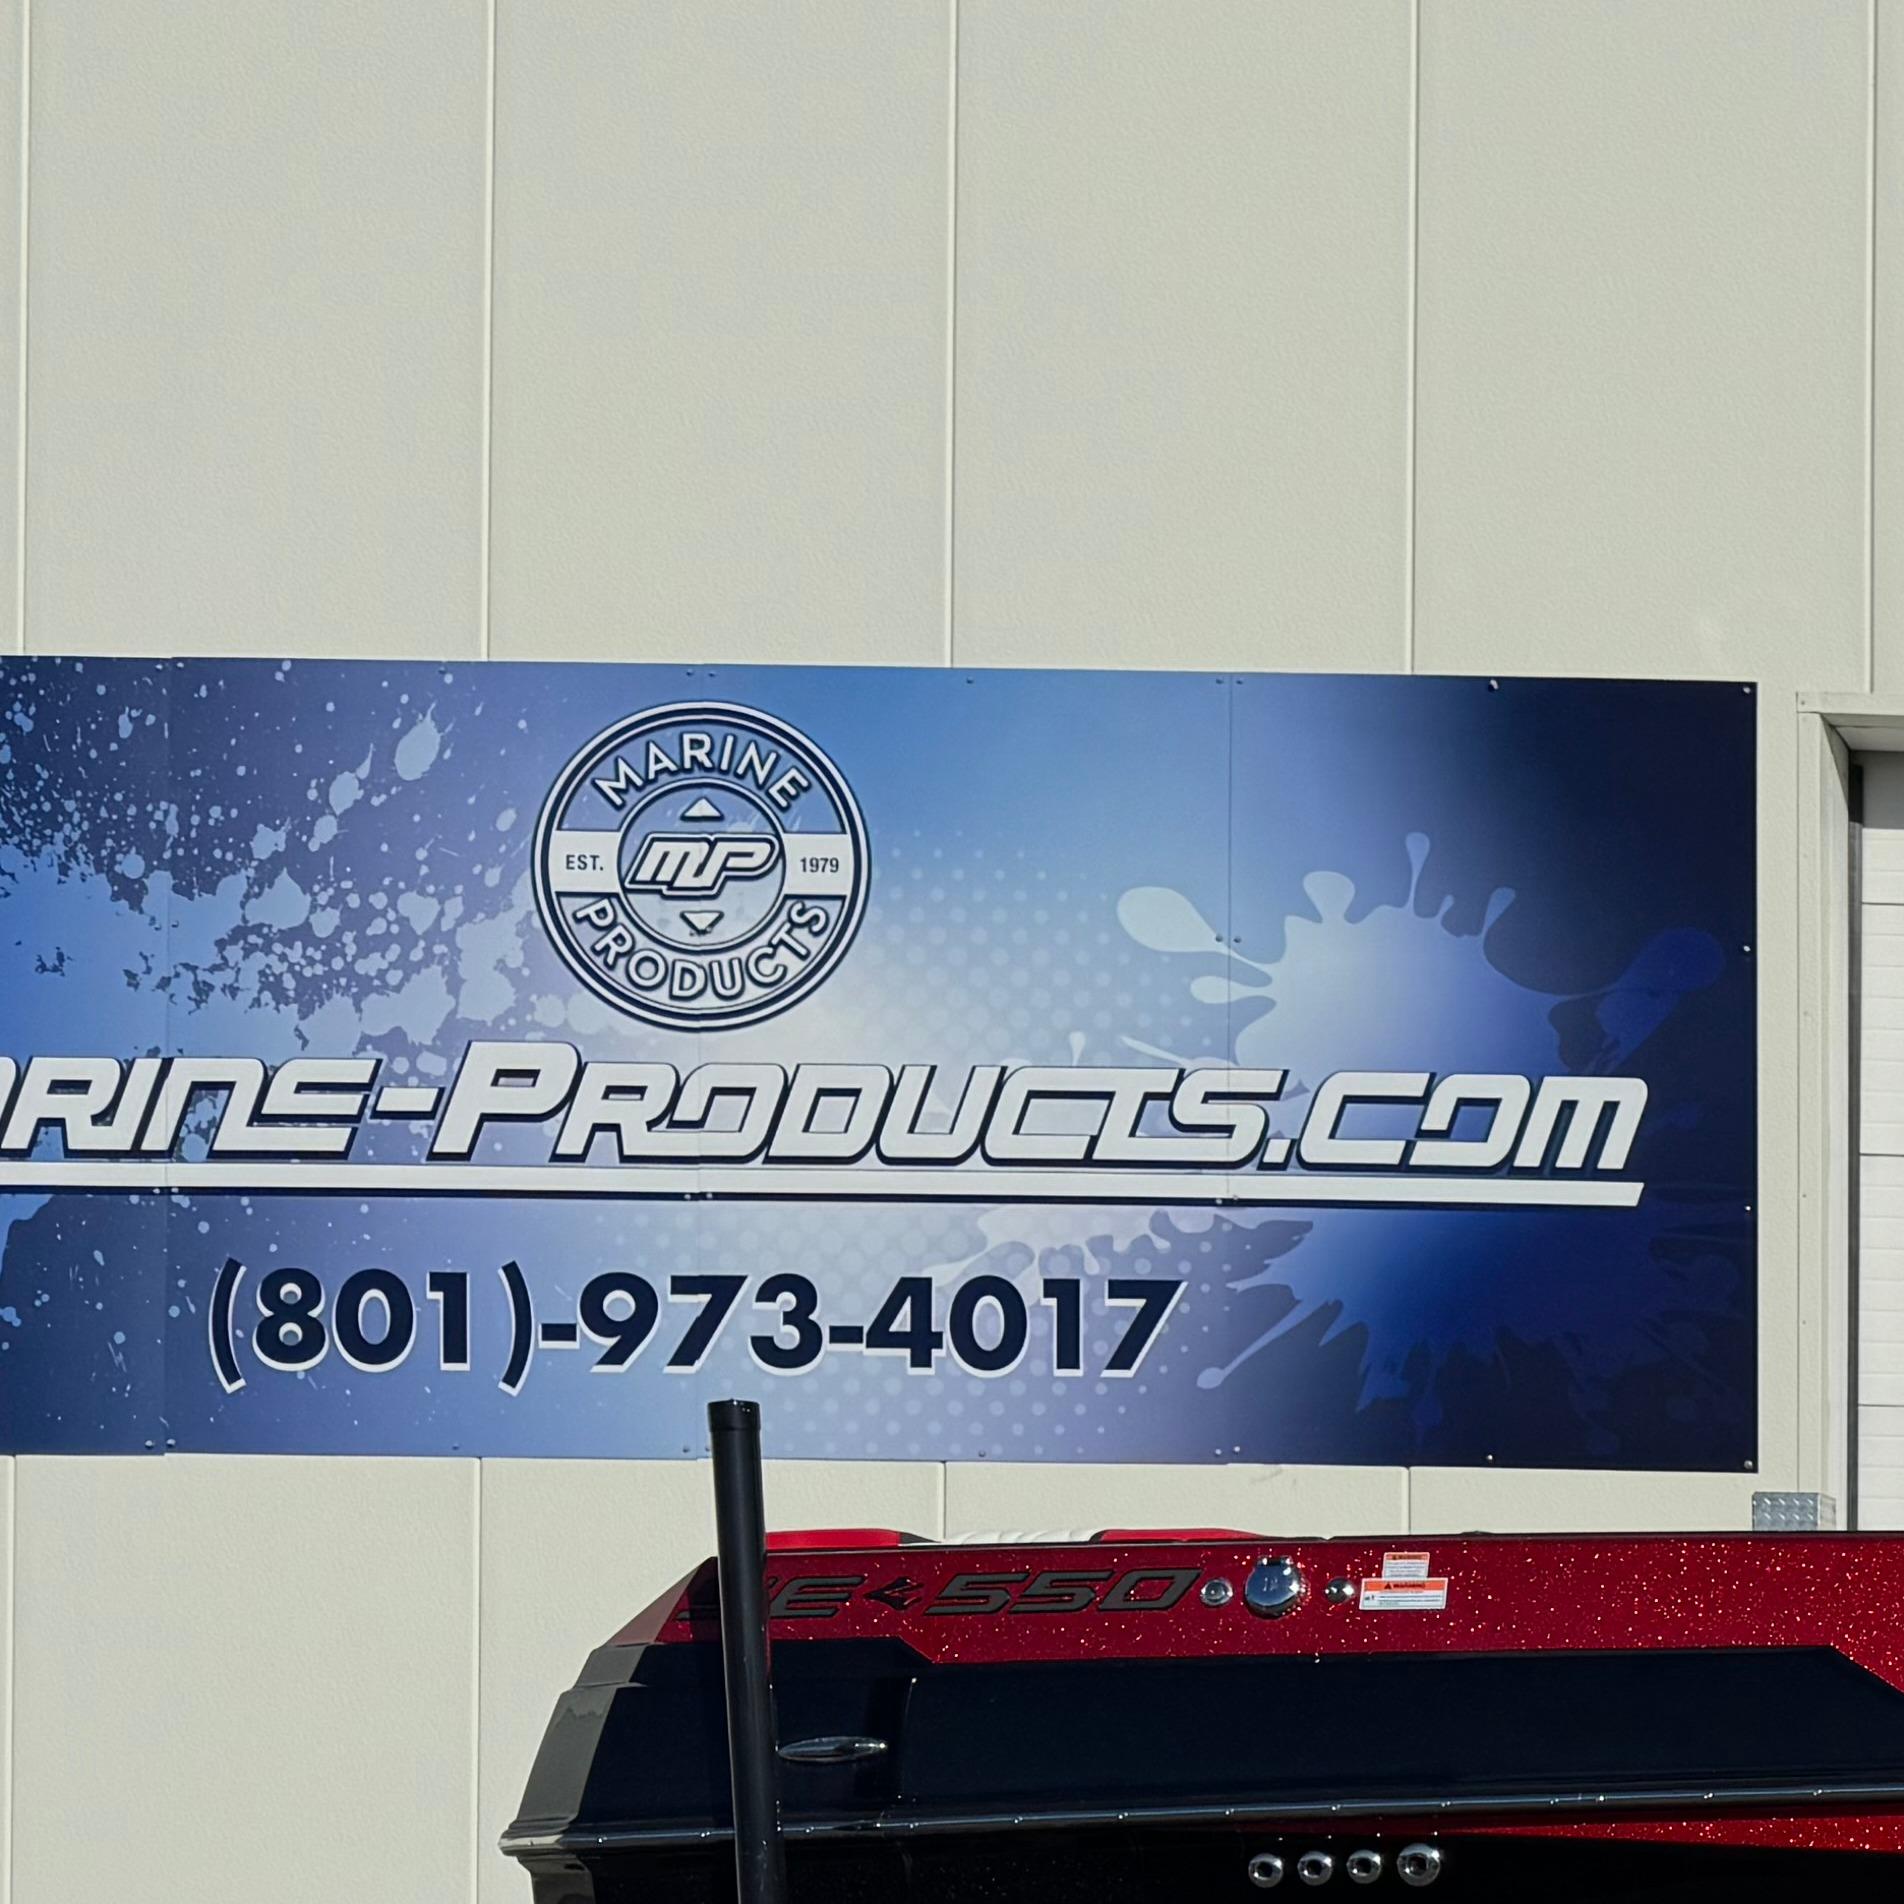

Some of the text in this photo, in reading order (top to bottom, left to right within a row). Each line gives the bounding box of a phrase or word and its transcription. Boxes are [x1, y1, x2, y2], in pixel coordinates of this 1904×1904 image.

[593, 731, 811, 811] MARINE
[565, 853, 605, 871] EST.
[799, 856, 840, 873] 1979
[573, 897, 829, 1001] PRODUCTS
[0, 1041, 1650, 1170] RINE-PRODUCTS.COM
[209, 1257, 1190, 1396] (801)-973-4017
[924, 1568, 1201, 1617] 550
